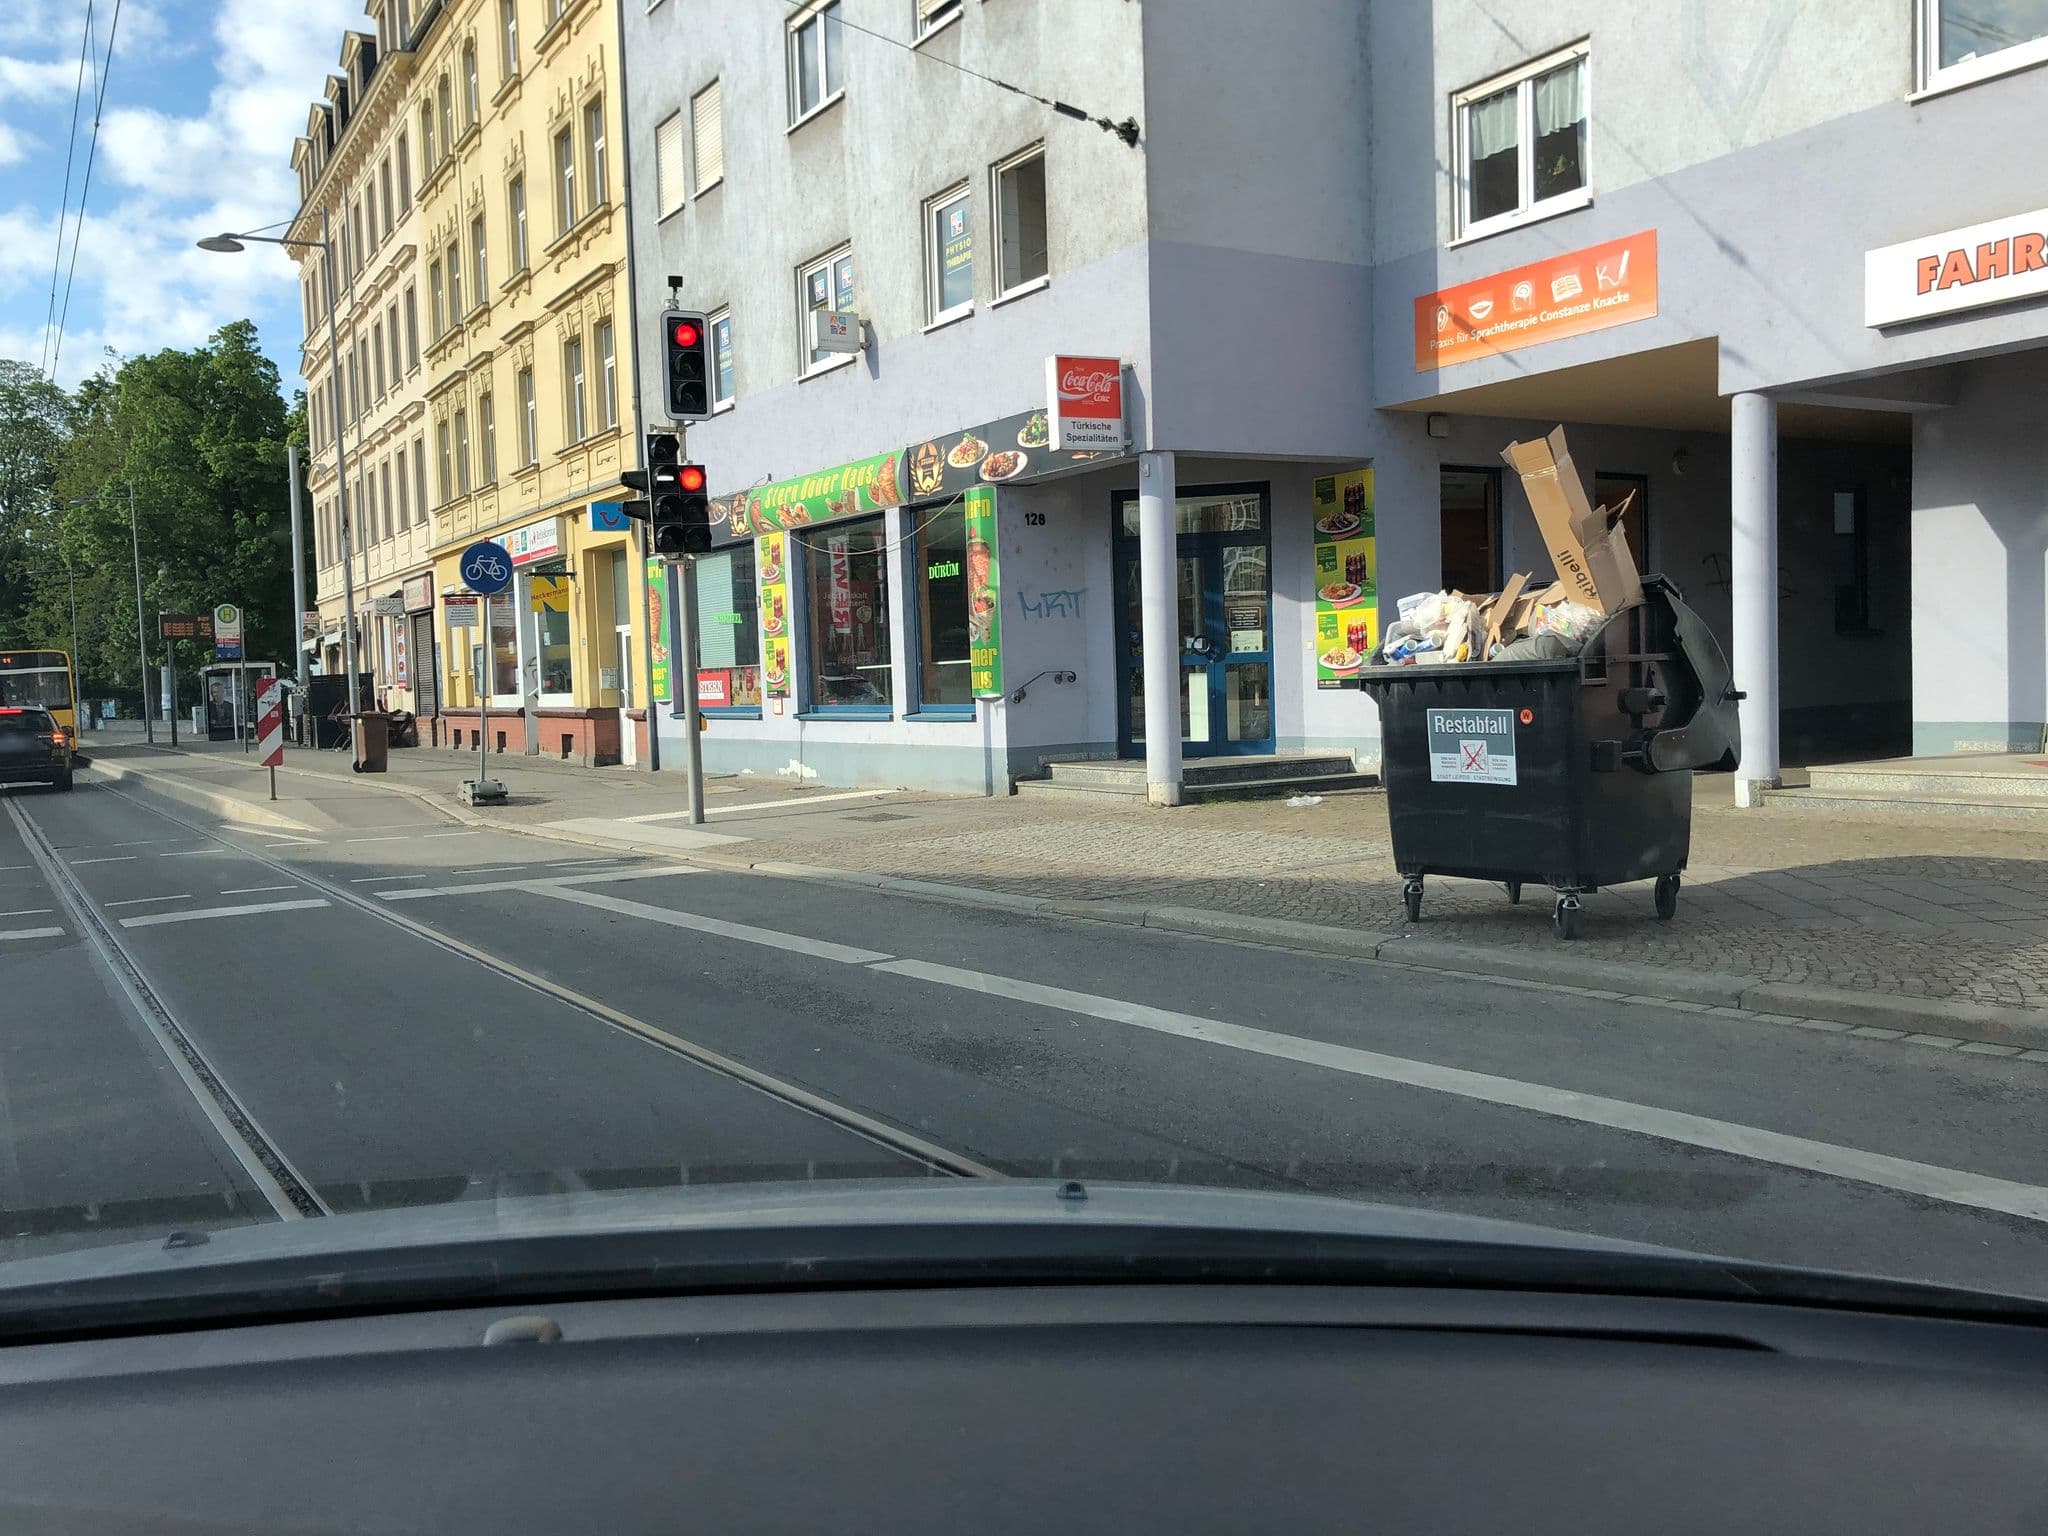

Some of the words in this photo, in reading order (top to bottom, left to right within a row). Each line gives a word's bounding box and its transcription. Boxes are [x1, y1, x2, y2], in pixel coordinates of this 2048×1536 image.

[1917, 231, 2048, 295] FAHR
[1430, 337, 1455, 351] Praxis
[1456, 330, 1470, 343] für
[1471, 315, 1538, 341] Sprachtherapie
[1540, 303, 1590, 322] Constanze
[1593, 291, 1630, 309] Knacke
[1071, 421, 1112, 431] Türkische
[1066, 433, 1119, 443] Spezialitäten
[765, 484, 799, 509] Stern
[1024, 513, 1046, 526] 128
[1557, 550, 1598, 598] Ribelli
[1434, 715, 1507, 734] Restabfall
[1522, 711, 1530, 720] W
